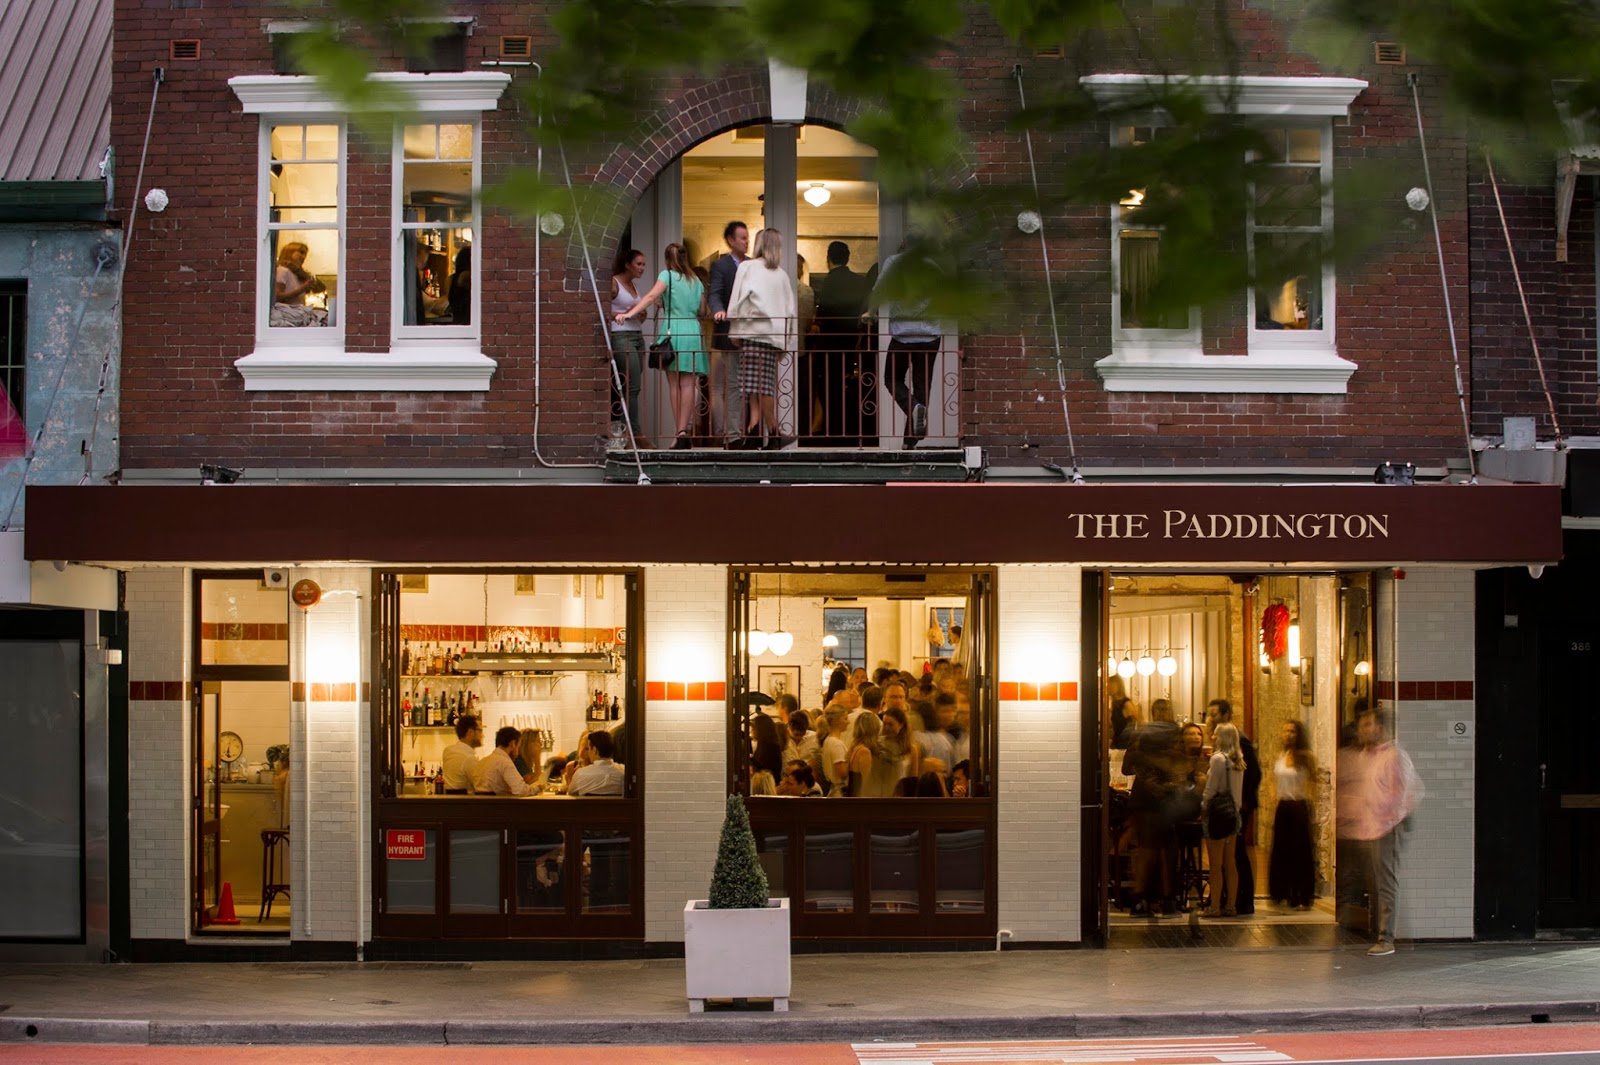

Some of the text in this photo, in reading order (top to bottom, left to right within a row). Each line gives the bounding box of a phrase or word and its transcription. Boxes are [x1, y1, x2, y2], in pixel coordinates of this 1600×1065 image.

[1068, 509, 1389, 539] THE PADDINGTON
[397, 834, 415, 843] FIRE
[388, 846, 424, 855] HYDRANT
